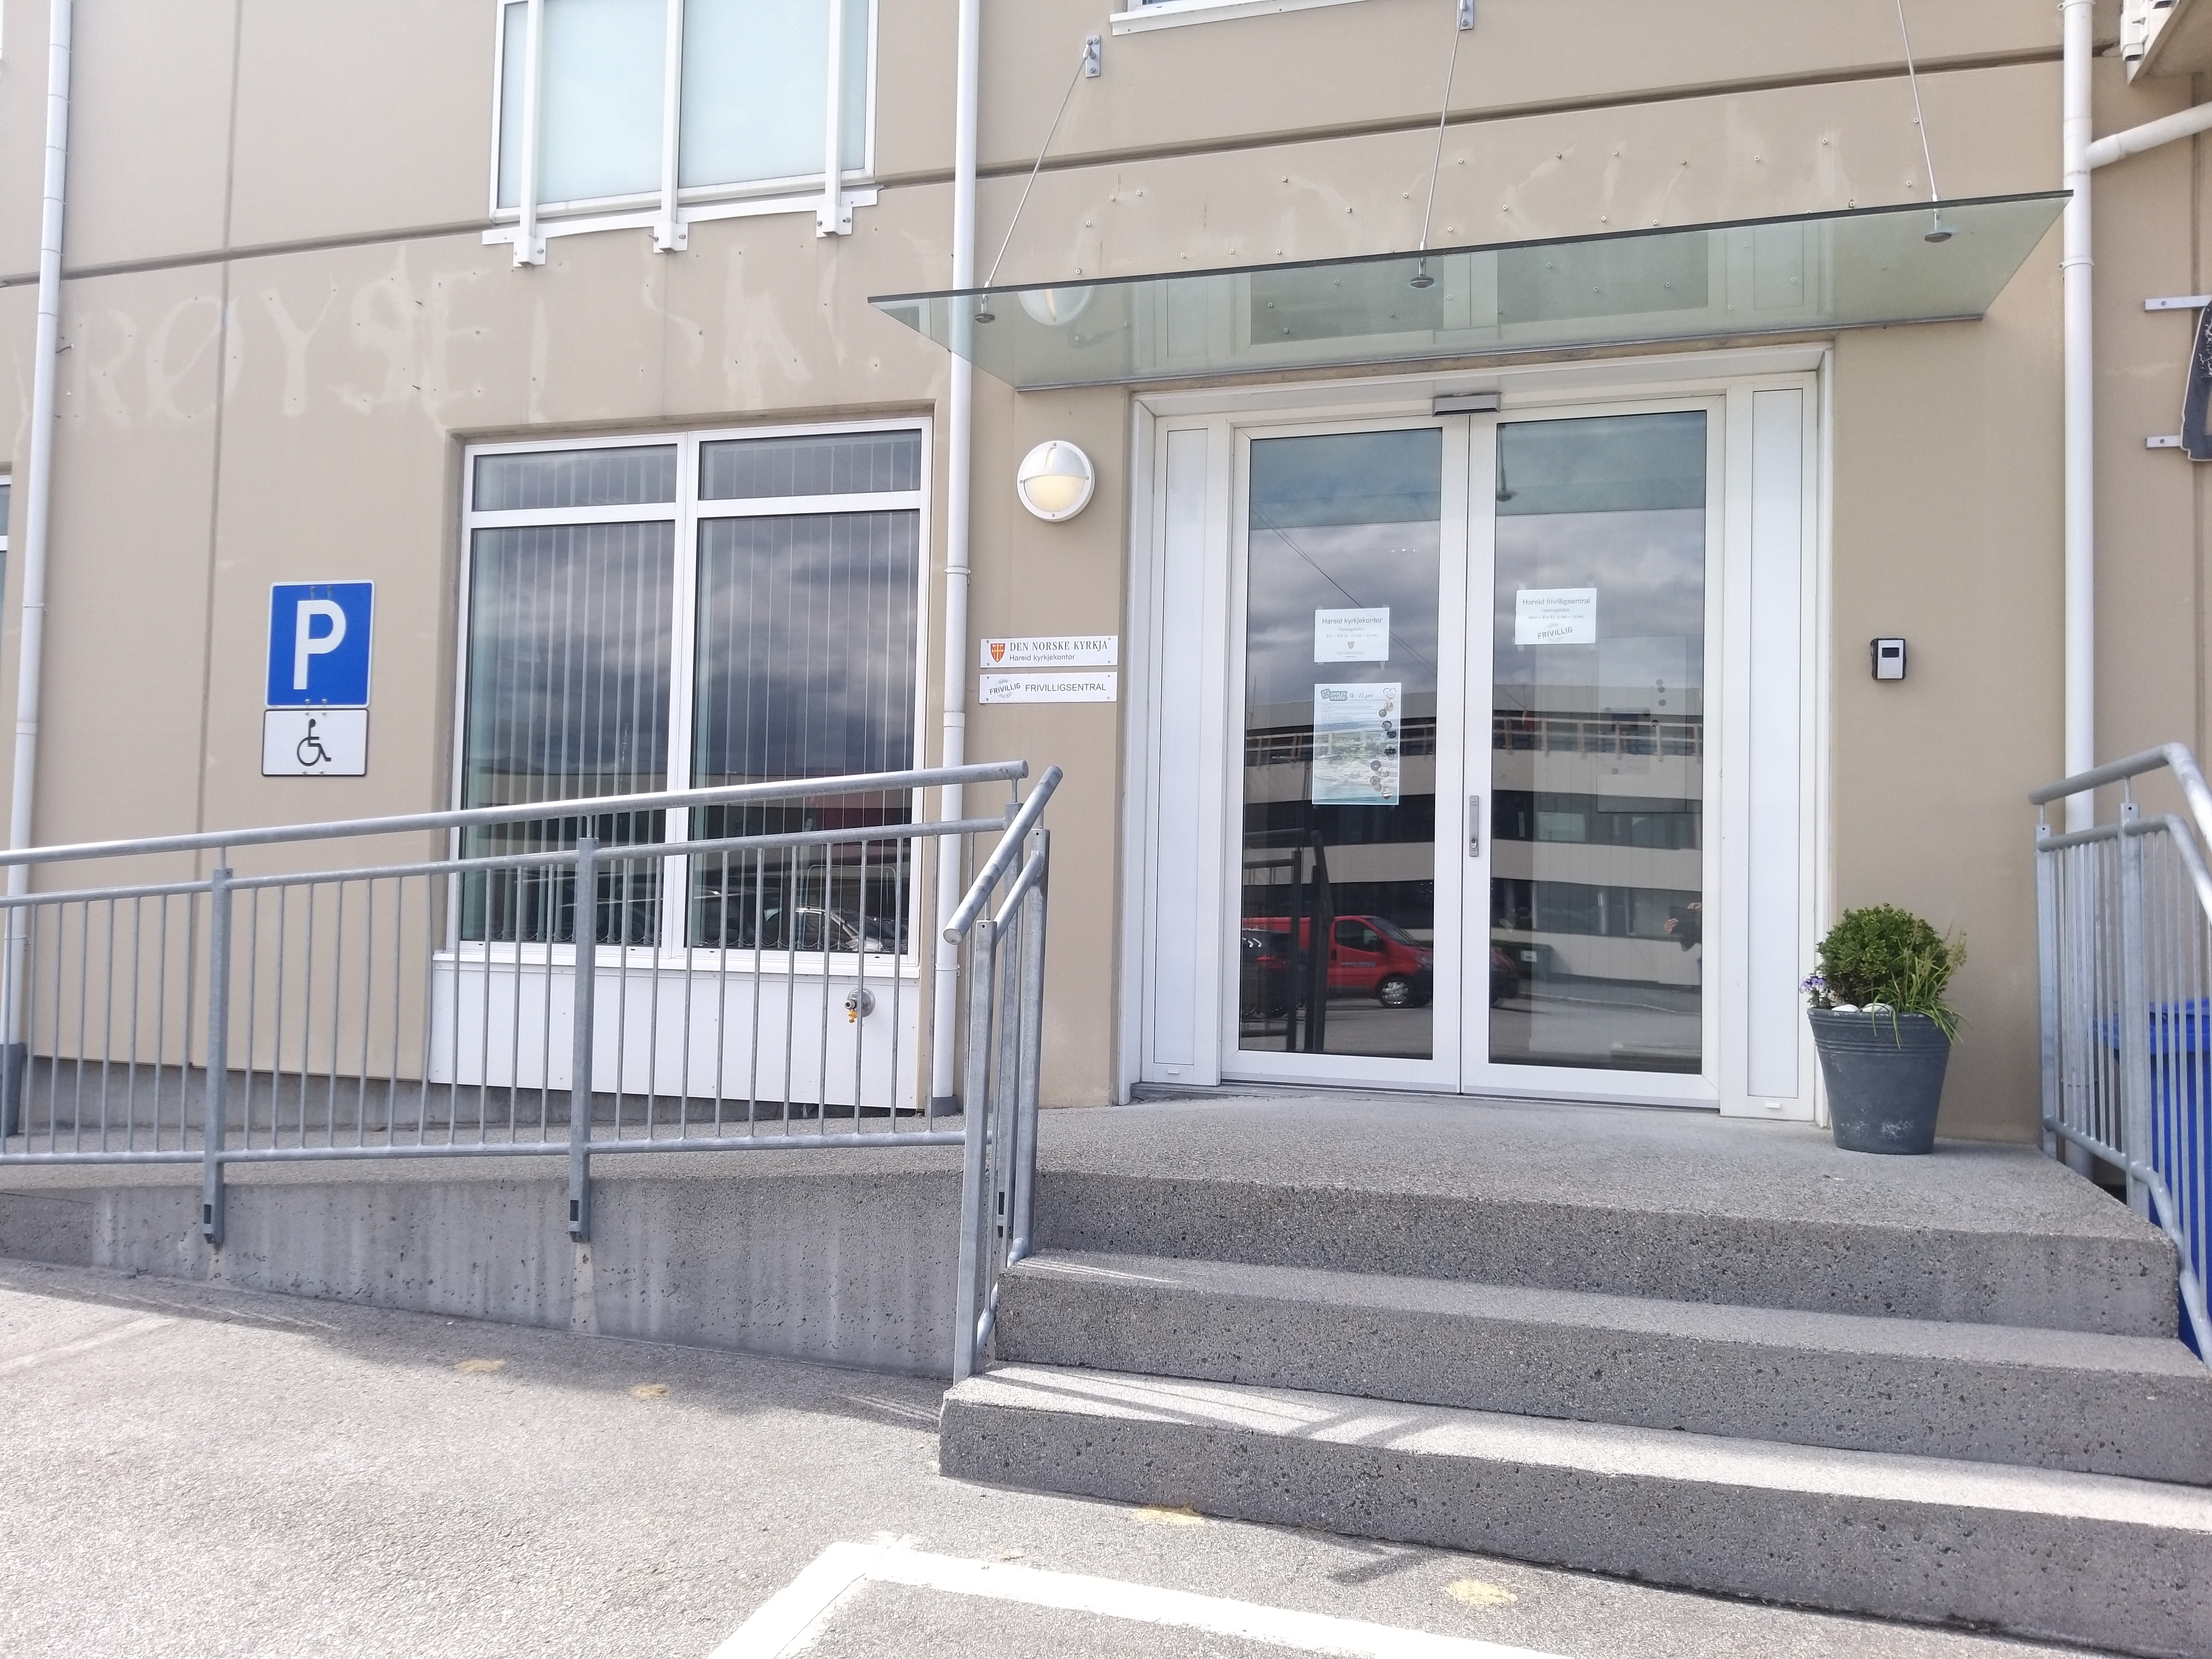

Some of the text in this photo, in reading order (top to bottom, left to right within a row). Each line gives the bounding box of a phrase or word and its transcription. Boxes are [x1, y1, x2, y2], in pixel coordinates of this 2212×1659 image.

[1538, 627, 1573, 639] FRIVILLIG
[293, 600, 346, 689] P
[1010, 640, 1108, 652] DEN NORSKE KYRKJA
[1033, 653, 1075, 662] kyrkjekontor
[989, 683, 1106, 695] FRIVILLIG FRIVILLIGSENTRAL
